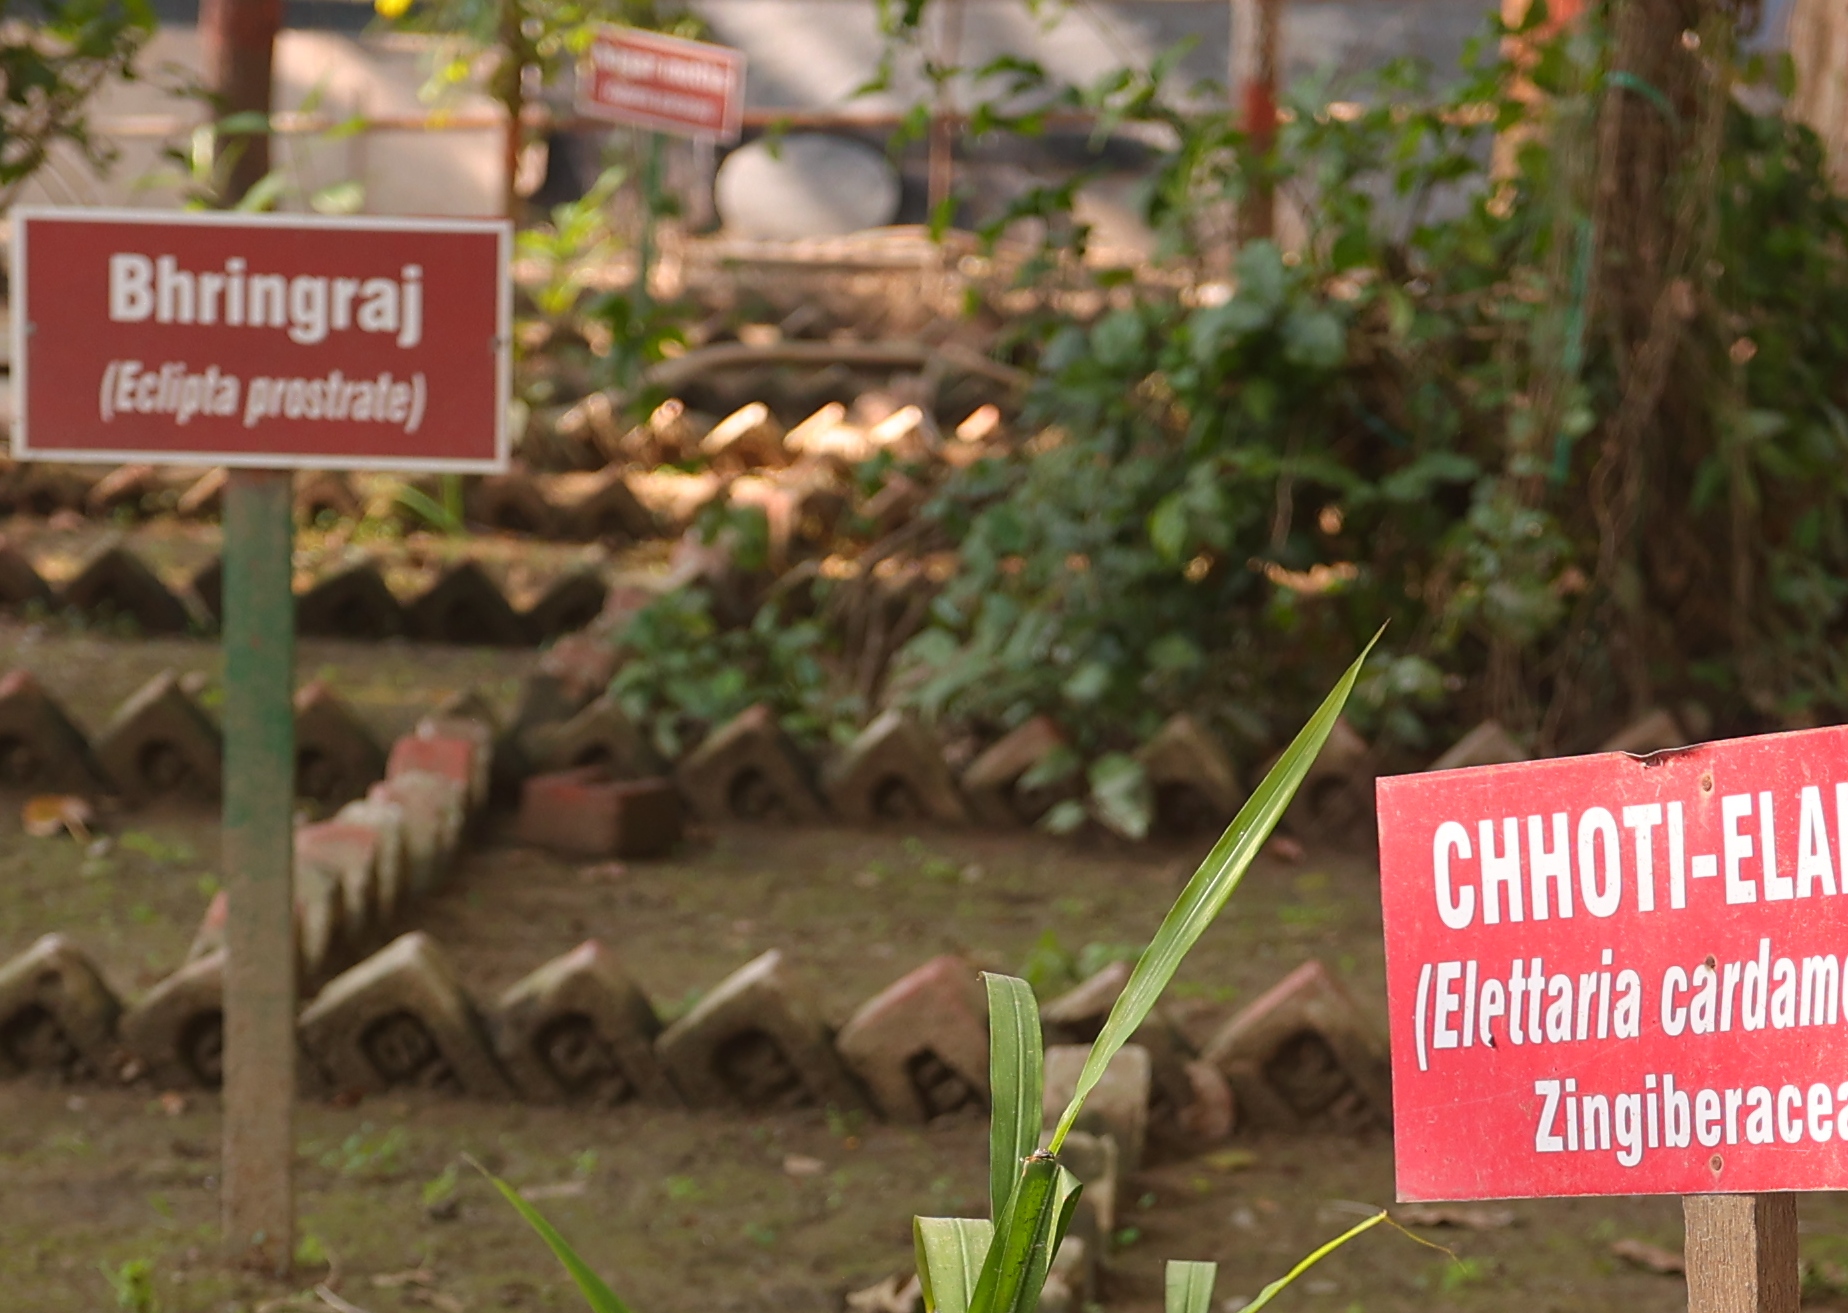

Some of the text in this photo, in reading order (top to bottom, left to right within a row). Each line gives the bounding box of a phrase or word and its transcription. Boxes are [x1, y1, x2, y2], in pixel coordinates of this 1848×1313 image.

[107, 252, 423, 349] Bhringraj
[100, 360, 428, 434] (Eclipta prostrate)
[1414, 948, 1642, 1071] (Elettaria
